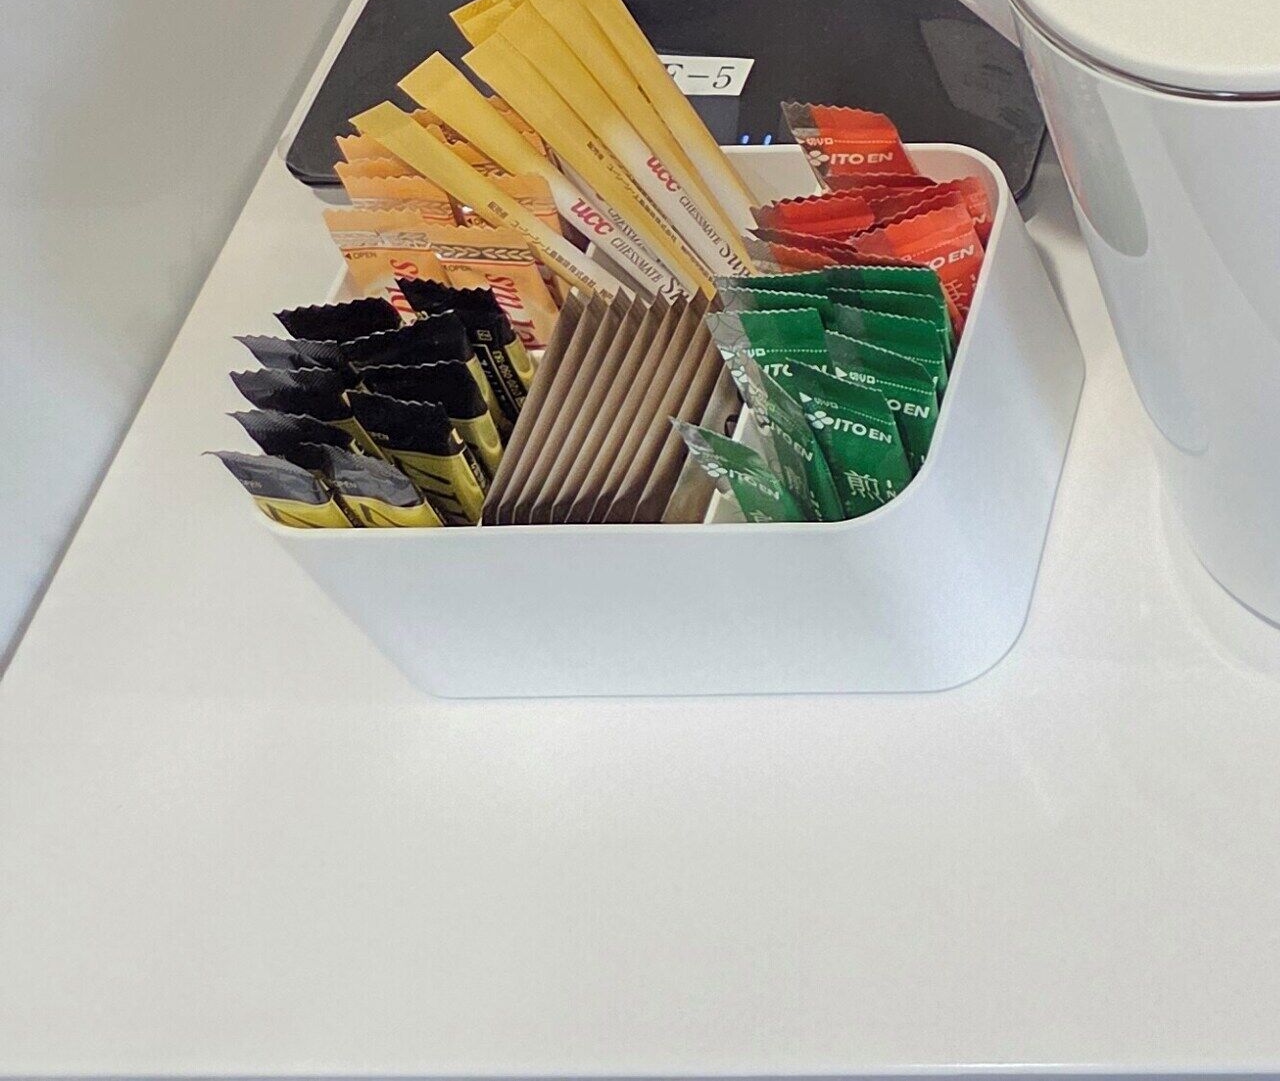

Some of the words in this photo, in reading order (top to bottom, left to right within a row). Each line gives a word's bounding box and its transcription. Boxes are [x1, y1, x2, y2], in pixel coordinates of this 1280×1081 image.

[830, 153, 864, 165] ITO
[868, 152, 894, 163] EN
[679, 195, 721, 245] CHESSMATE
[610, 237, 664, 283] CHESSMATE
[833, 417, 867, 436] ITO
[868, 429, 892, 444] EN
